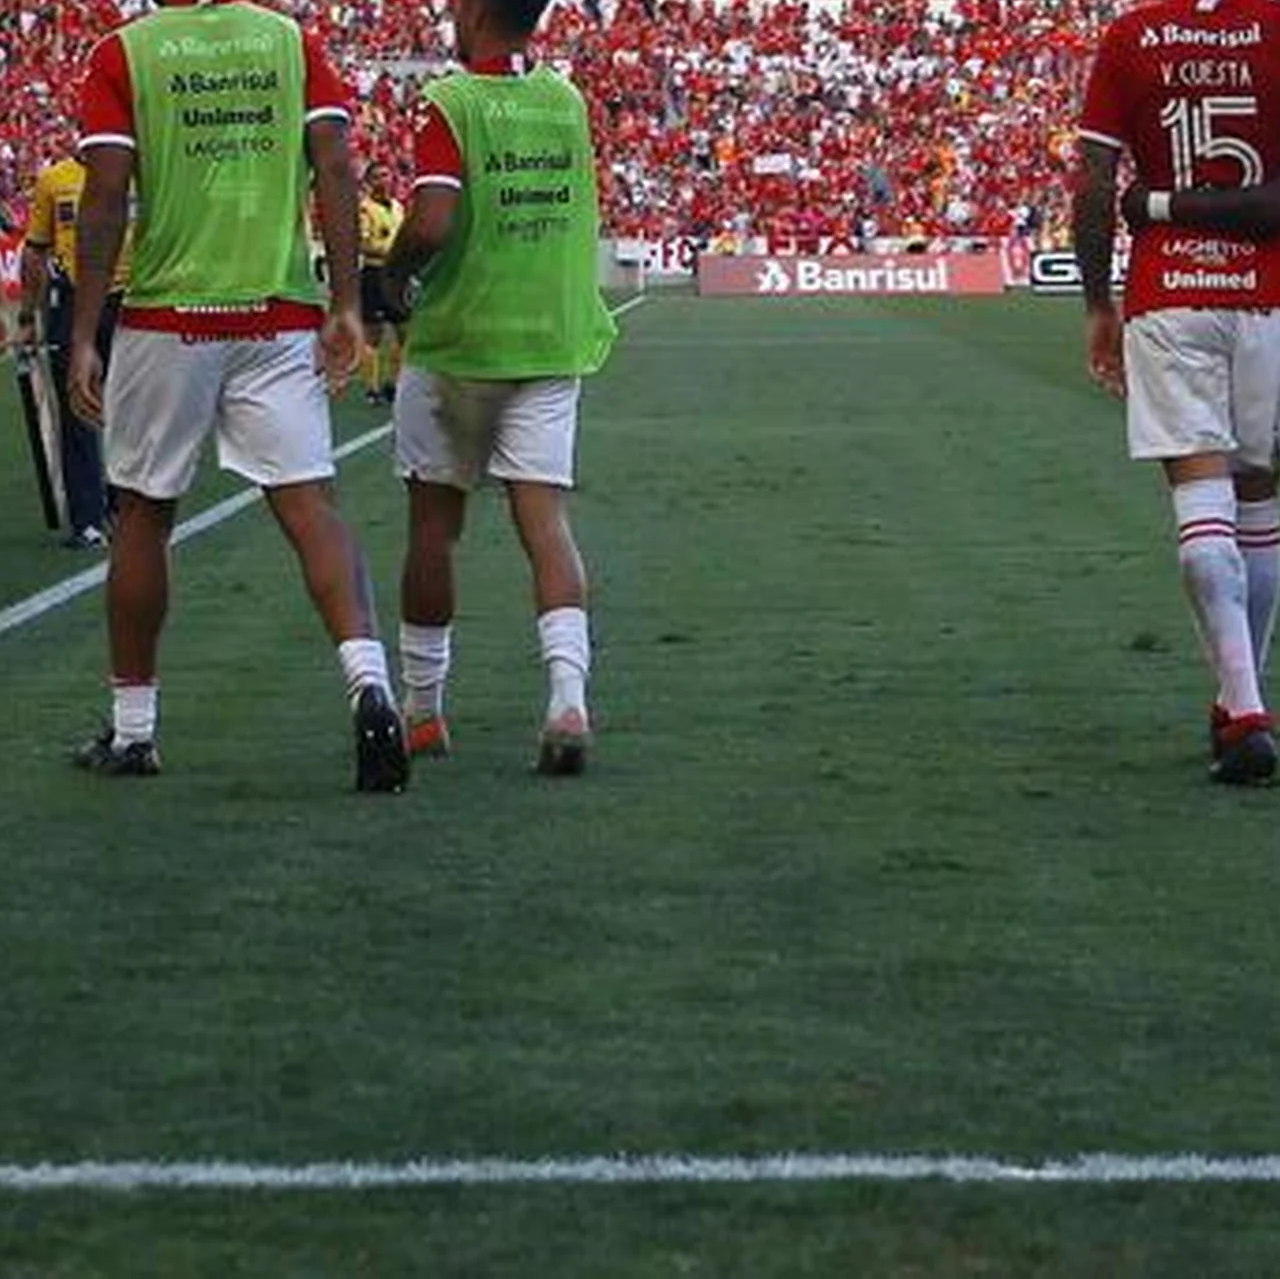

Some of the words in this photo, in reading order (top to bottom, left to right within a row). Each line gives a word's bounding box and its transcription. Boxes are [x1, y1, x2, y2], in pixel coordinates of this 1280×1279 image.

[1162, 23, 1261, 45] Banrisul
[188, 71, 279, 94] Banrisul
[183, 105, 274, 127] Unimed
[1161, 97, 1263, 191] 15
[797, 259, 949, 292] Banrisul
[1163, 269, 1257, 290] Unimed
